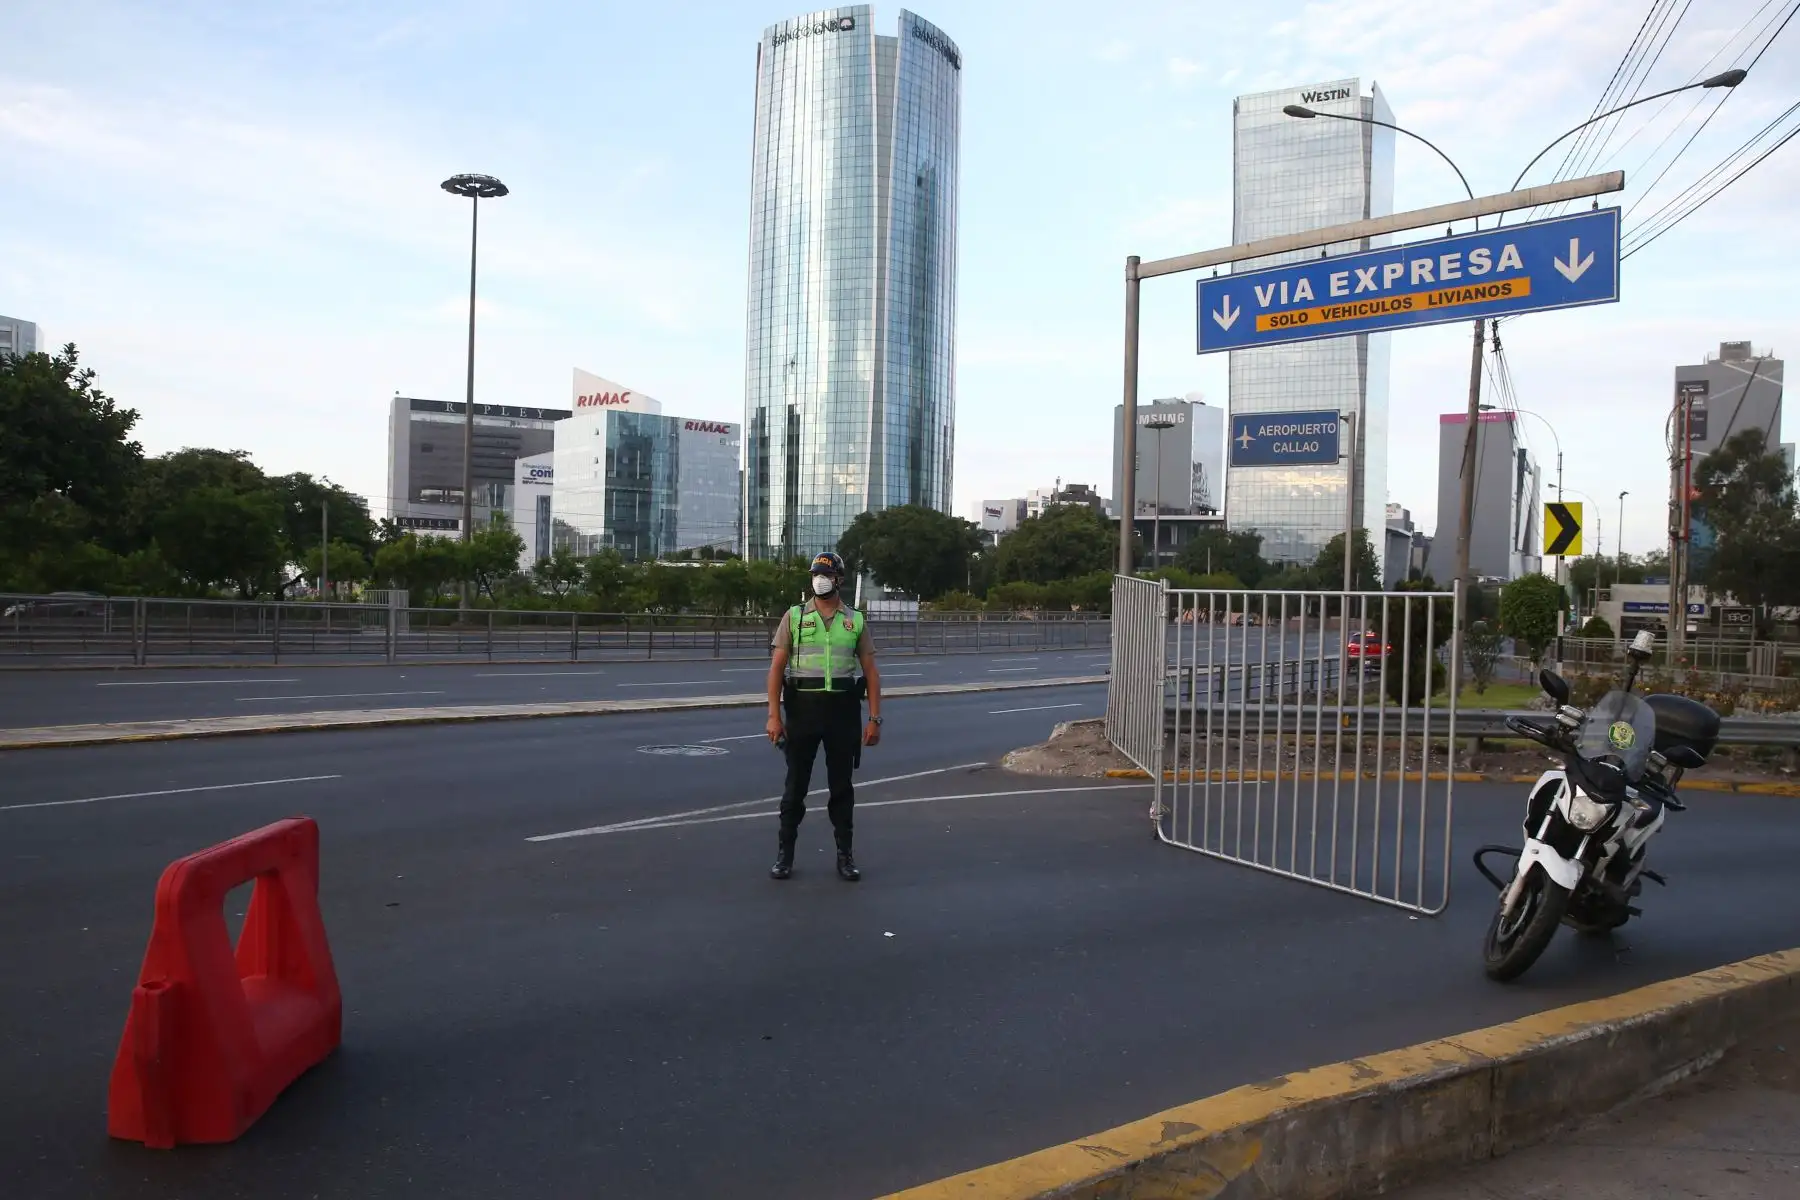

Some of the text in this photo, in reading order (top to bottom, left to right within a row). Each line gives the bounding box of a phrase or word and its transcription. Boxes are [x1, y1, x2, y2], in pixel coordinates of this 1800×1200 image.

[1254, 243, 1524, 308] VIA EXPRESA
[1270, 282, 1513, 328] SOLO VEHICULOS LIVIANOS
[577, 391, 631, 407] RIMAC
[445, 403, 545, 419] RPLEY
[1136, 412, 1185, 424] MSUNG
[684, 420, 731, 435] RIMAC
[1258, 422, 1337, 437] AEROPUERTO
[1273, 441, 1320, 453] CALLAO
[402, 518, 452, 526] RIPLEY
